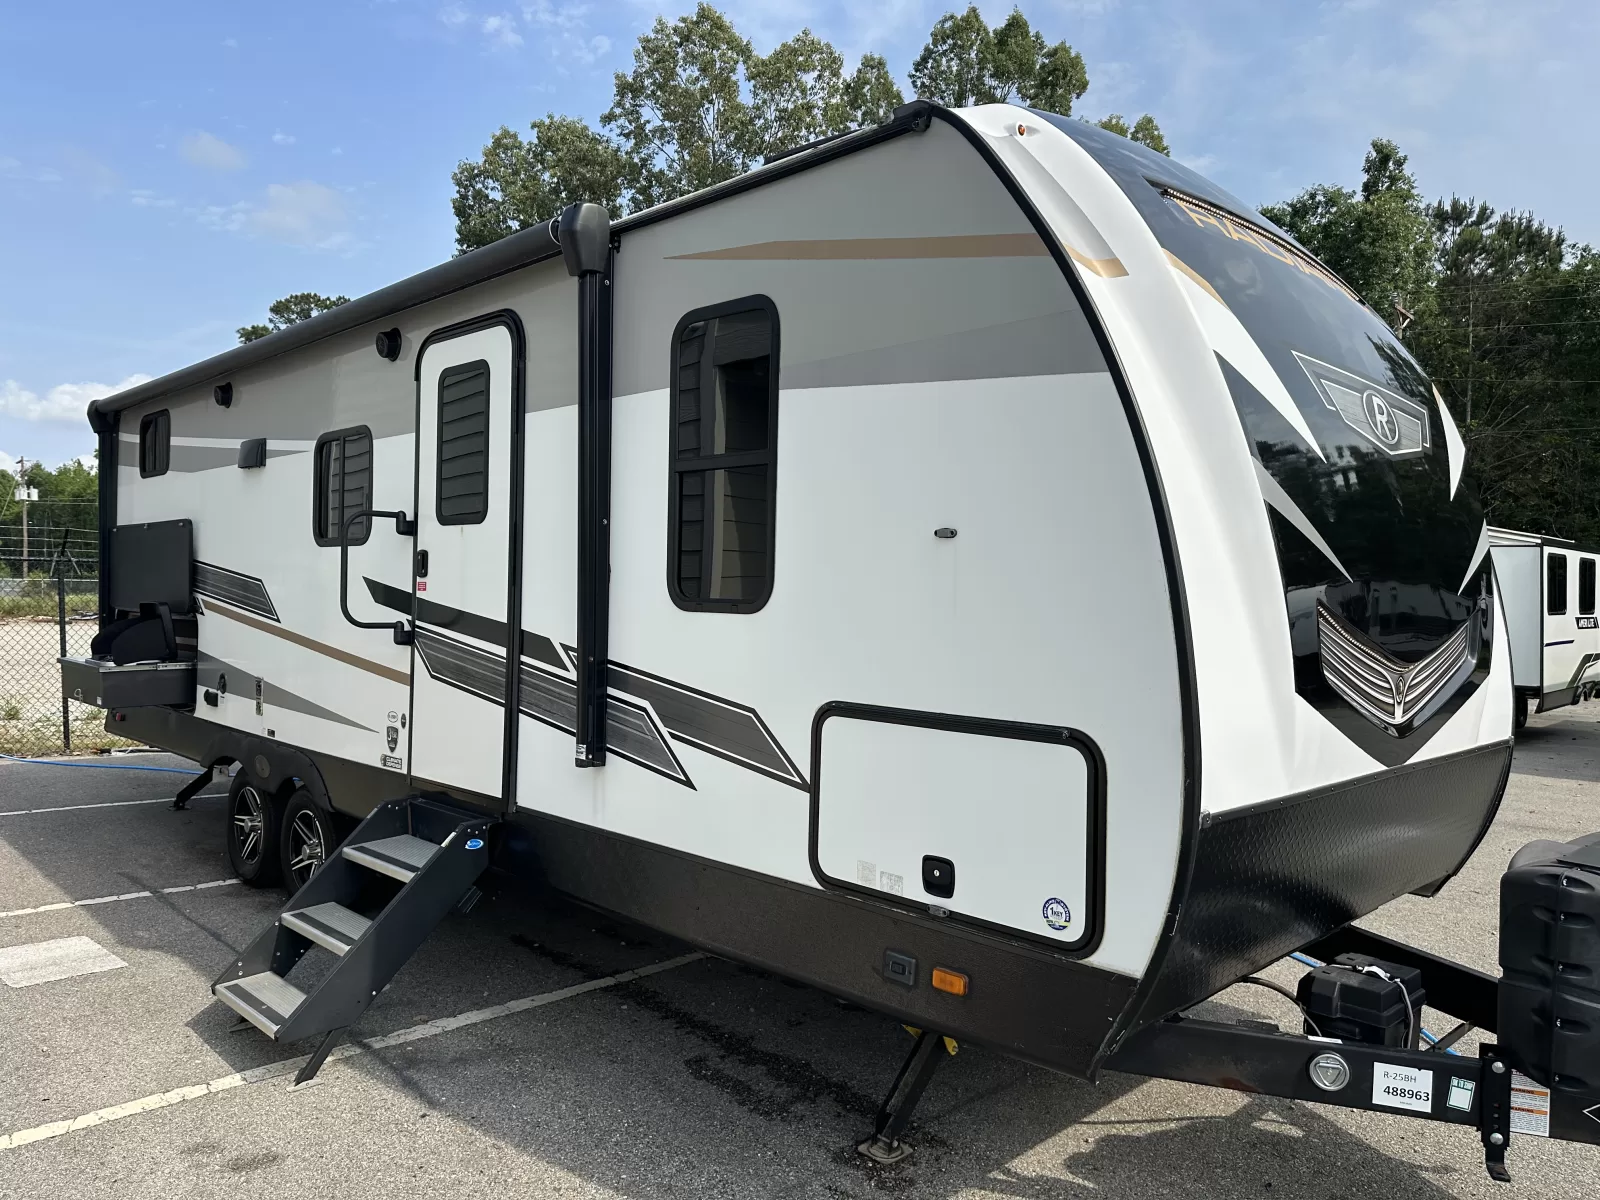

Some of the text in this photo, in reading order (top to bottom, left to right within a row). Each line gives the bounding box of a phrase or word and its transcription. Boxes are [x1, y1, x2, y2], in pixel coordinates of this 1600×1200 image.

[1371, 395, 1393, 441] R
[1383, 1071, 1417, 1083] R-25BH
[1383, 1085, 1430, 1102] 488963
